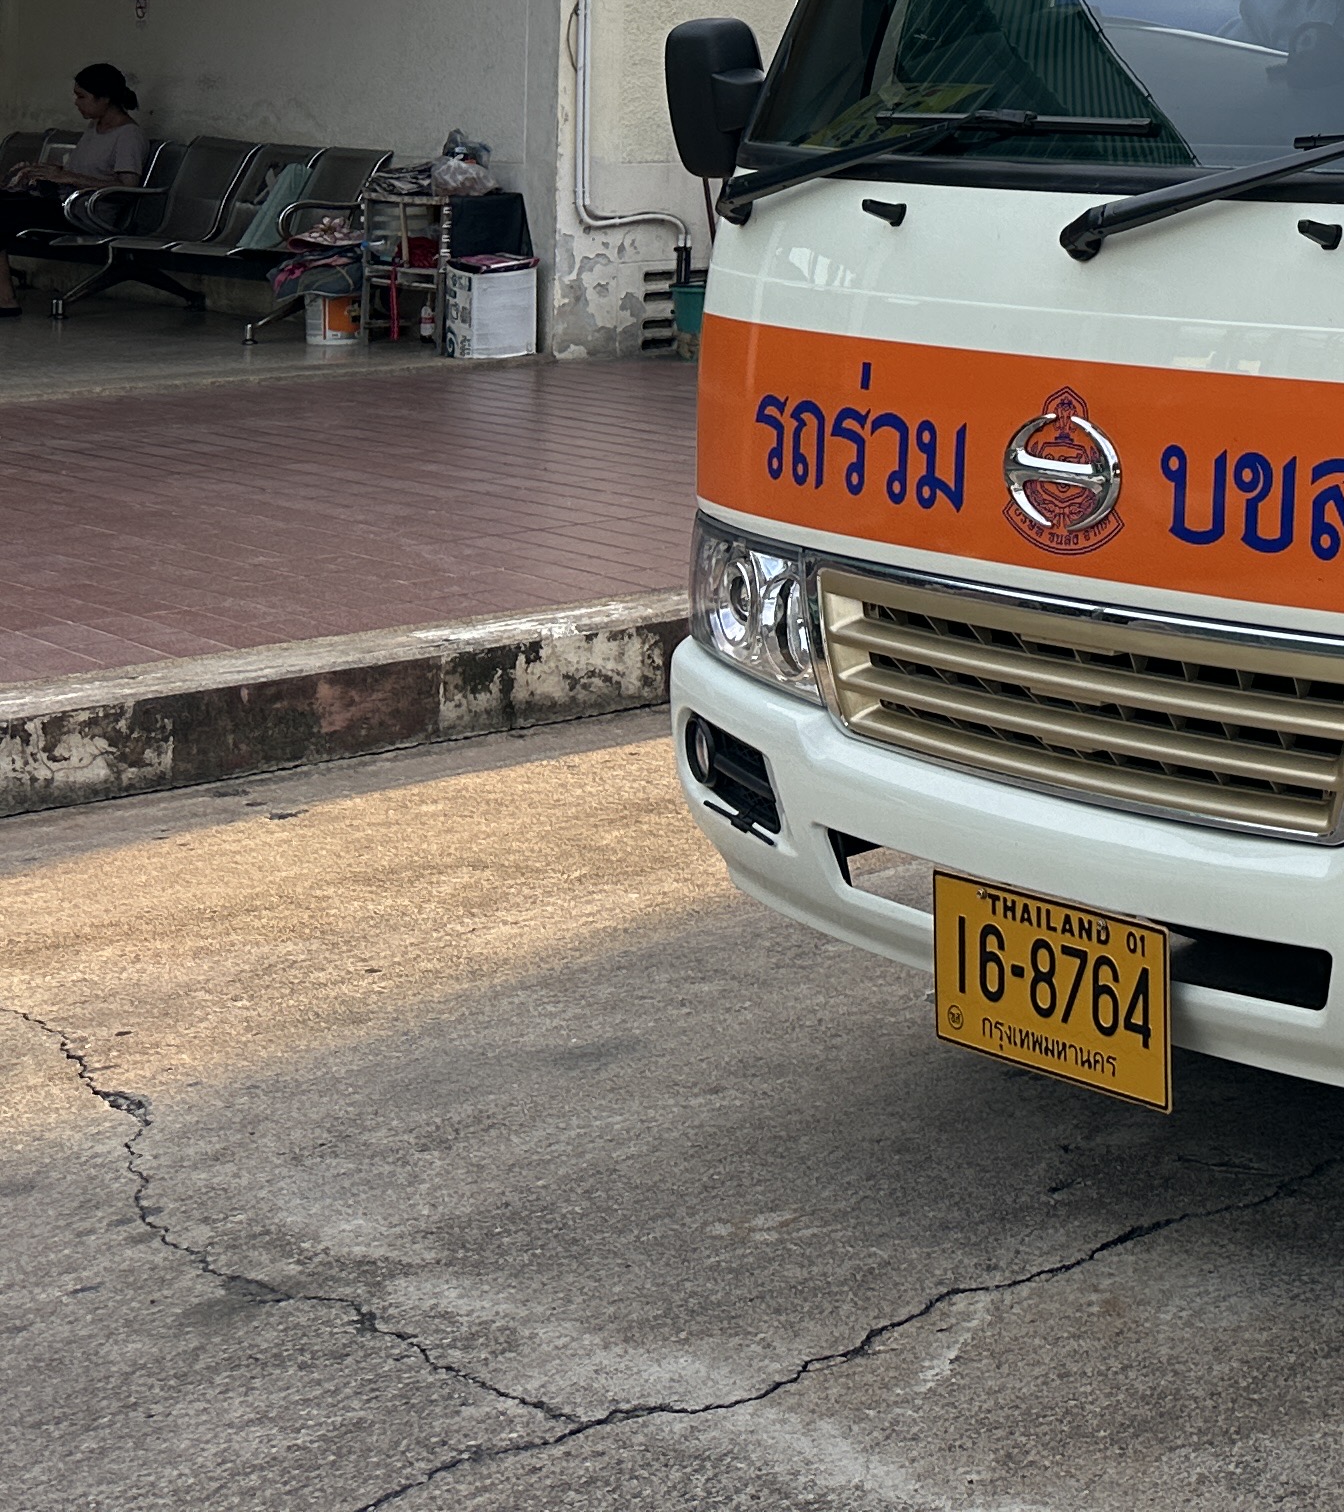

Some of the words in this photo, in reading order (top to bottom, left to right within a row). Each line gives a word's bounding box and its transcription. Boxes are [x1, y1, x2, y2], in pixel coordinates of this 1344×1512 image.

[755, 362, 968, 513] รถร่วม
[987, 892, 1110, 945] THAILAND
[1126, 931, 1147, 958] 01
[958, 915, 1152, 1049] 16-8764
[982, 1017, 1117, 1077] กรุงเทพมหานคร
